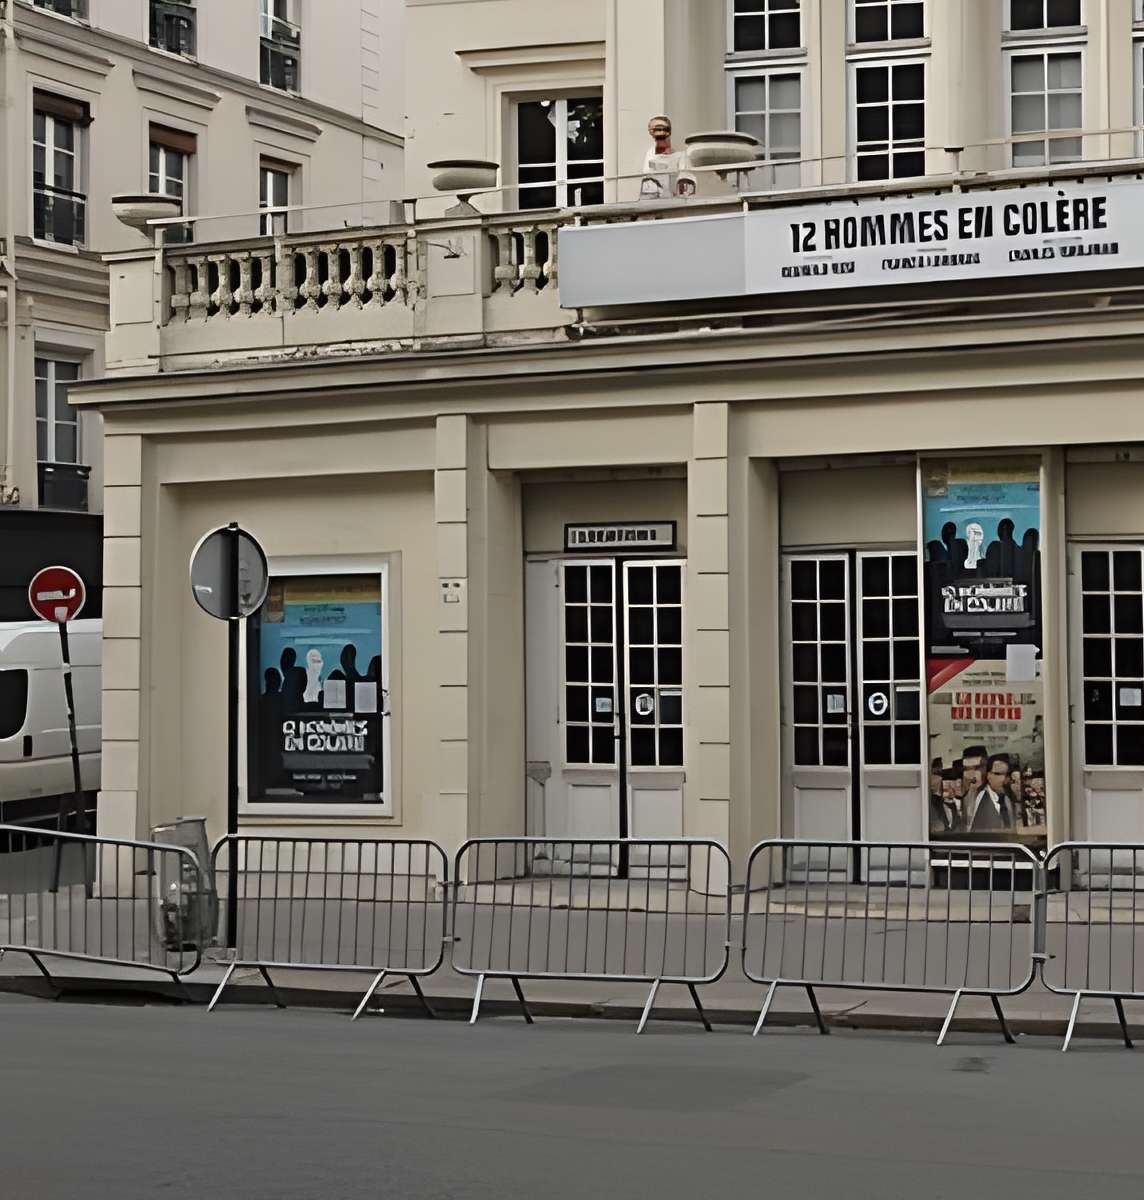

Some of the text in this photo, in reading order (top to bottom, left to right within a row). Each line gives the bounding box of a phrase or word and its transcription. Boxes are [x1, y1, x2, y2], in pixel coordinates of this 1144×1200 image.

[789, 190, 1108, 253] 12 HOMMES EN COLÈRE
